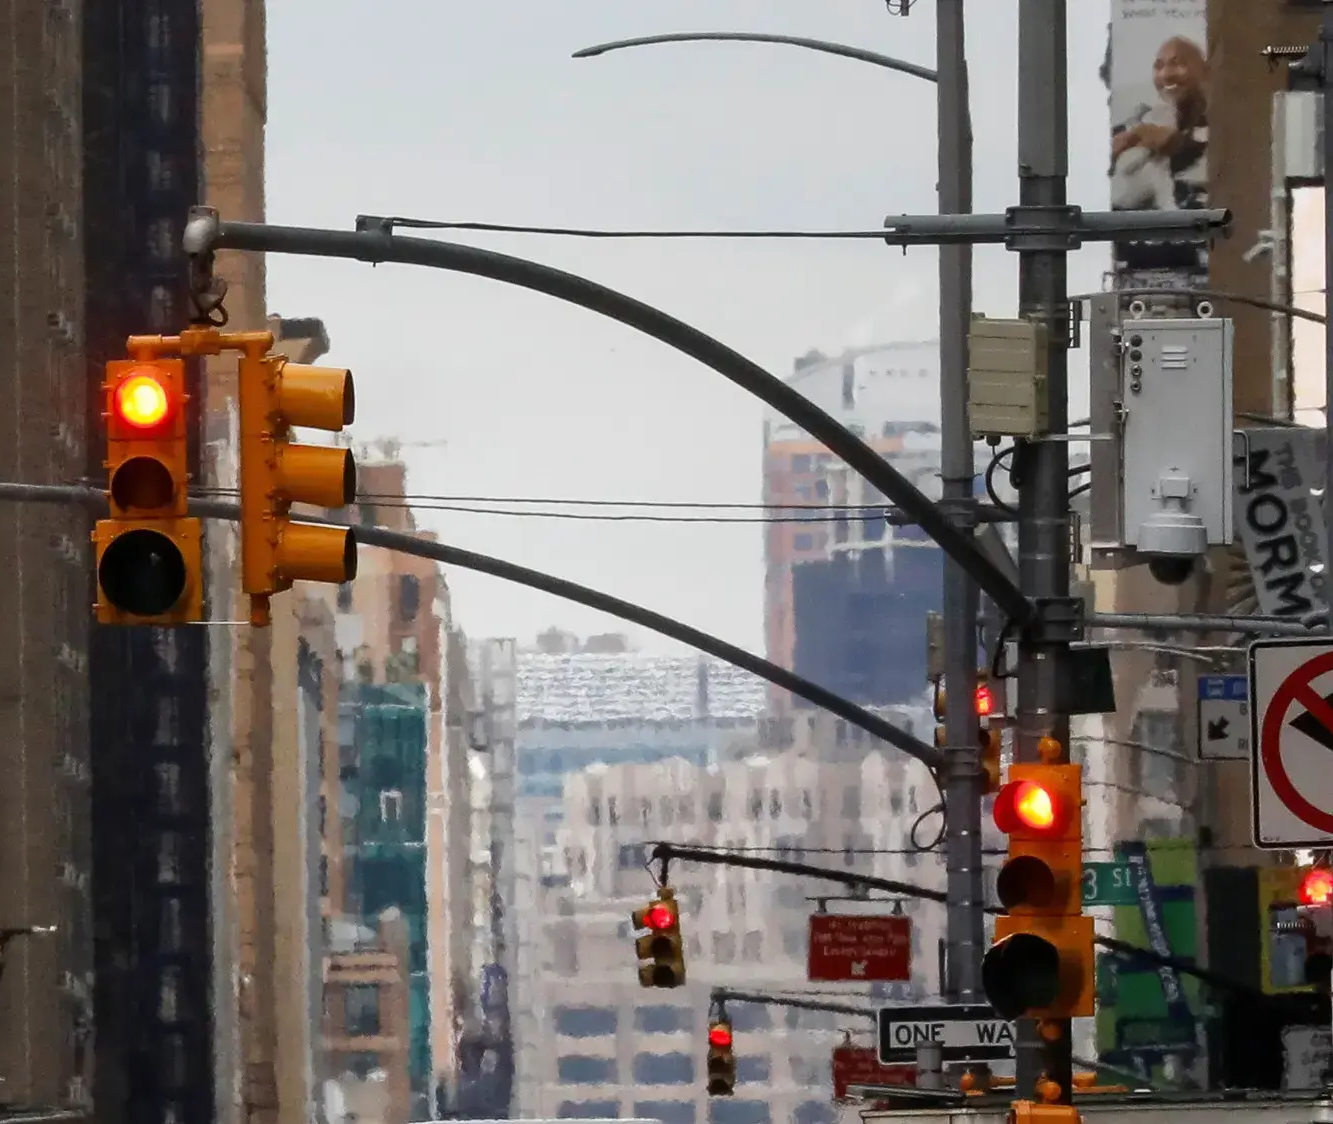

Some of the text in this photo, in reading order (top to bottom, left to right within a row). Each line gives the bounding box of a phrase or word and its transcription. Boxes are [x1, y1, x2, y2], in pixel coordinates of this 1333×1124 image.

[1083, 866, 1133, 901] 3 St
[894, 1022, 1017, 1045] ONE WA
